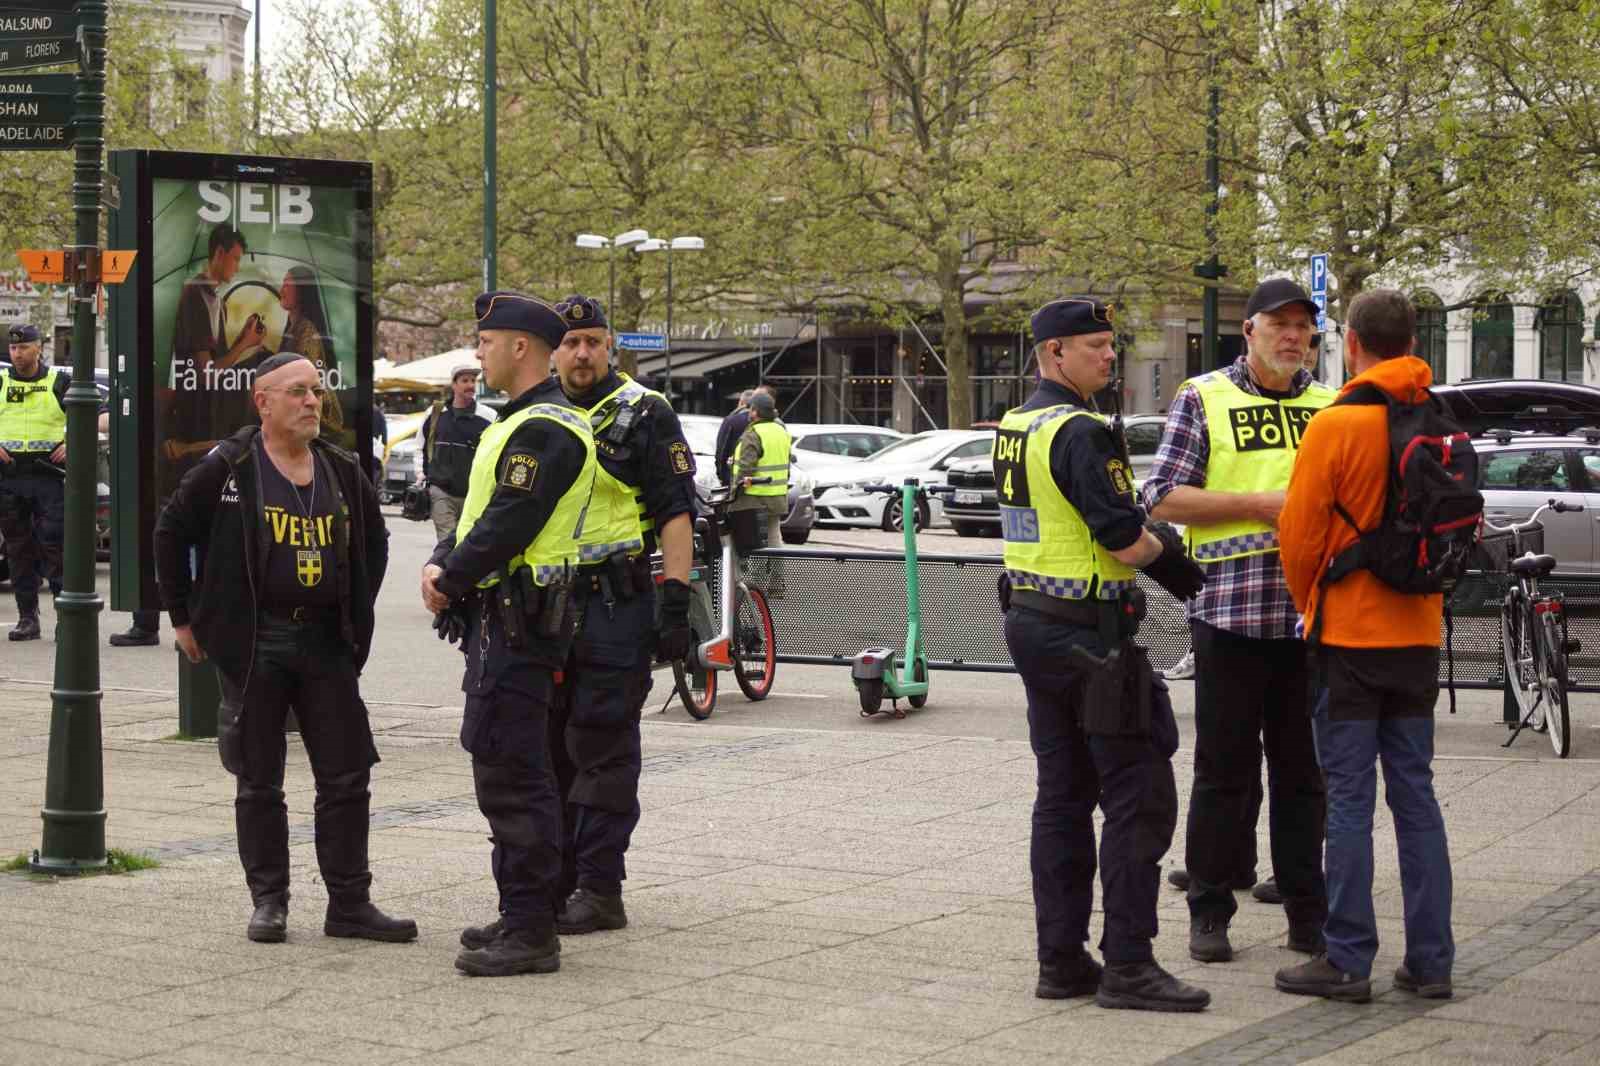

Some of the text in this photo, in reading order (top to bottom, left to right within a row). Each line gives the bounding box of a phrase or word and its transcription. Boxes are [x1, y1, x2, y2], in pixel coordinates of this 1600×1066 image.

[0, 16, 52, 31] RALSUND
[26, 41, 60, 58] FLORENS
[0, 83, 32, 93] ARNA
[0, 102, 38, 115] SHAN
[0, 127, 64, 140] ADELAIDE
[197, 181, 314, 224] SEB
[1314, 258, 1325, 289] P
[171, 358, 197, 391] Få
[998, 435, 1022, 463] D41
[511, 455, 536, 468] POLIS
[1003, 468, 1013, 500] 4
[264, 511, 334, 547] VERI
